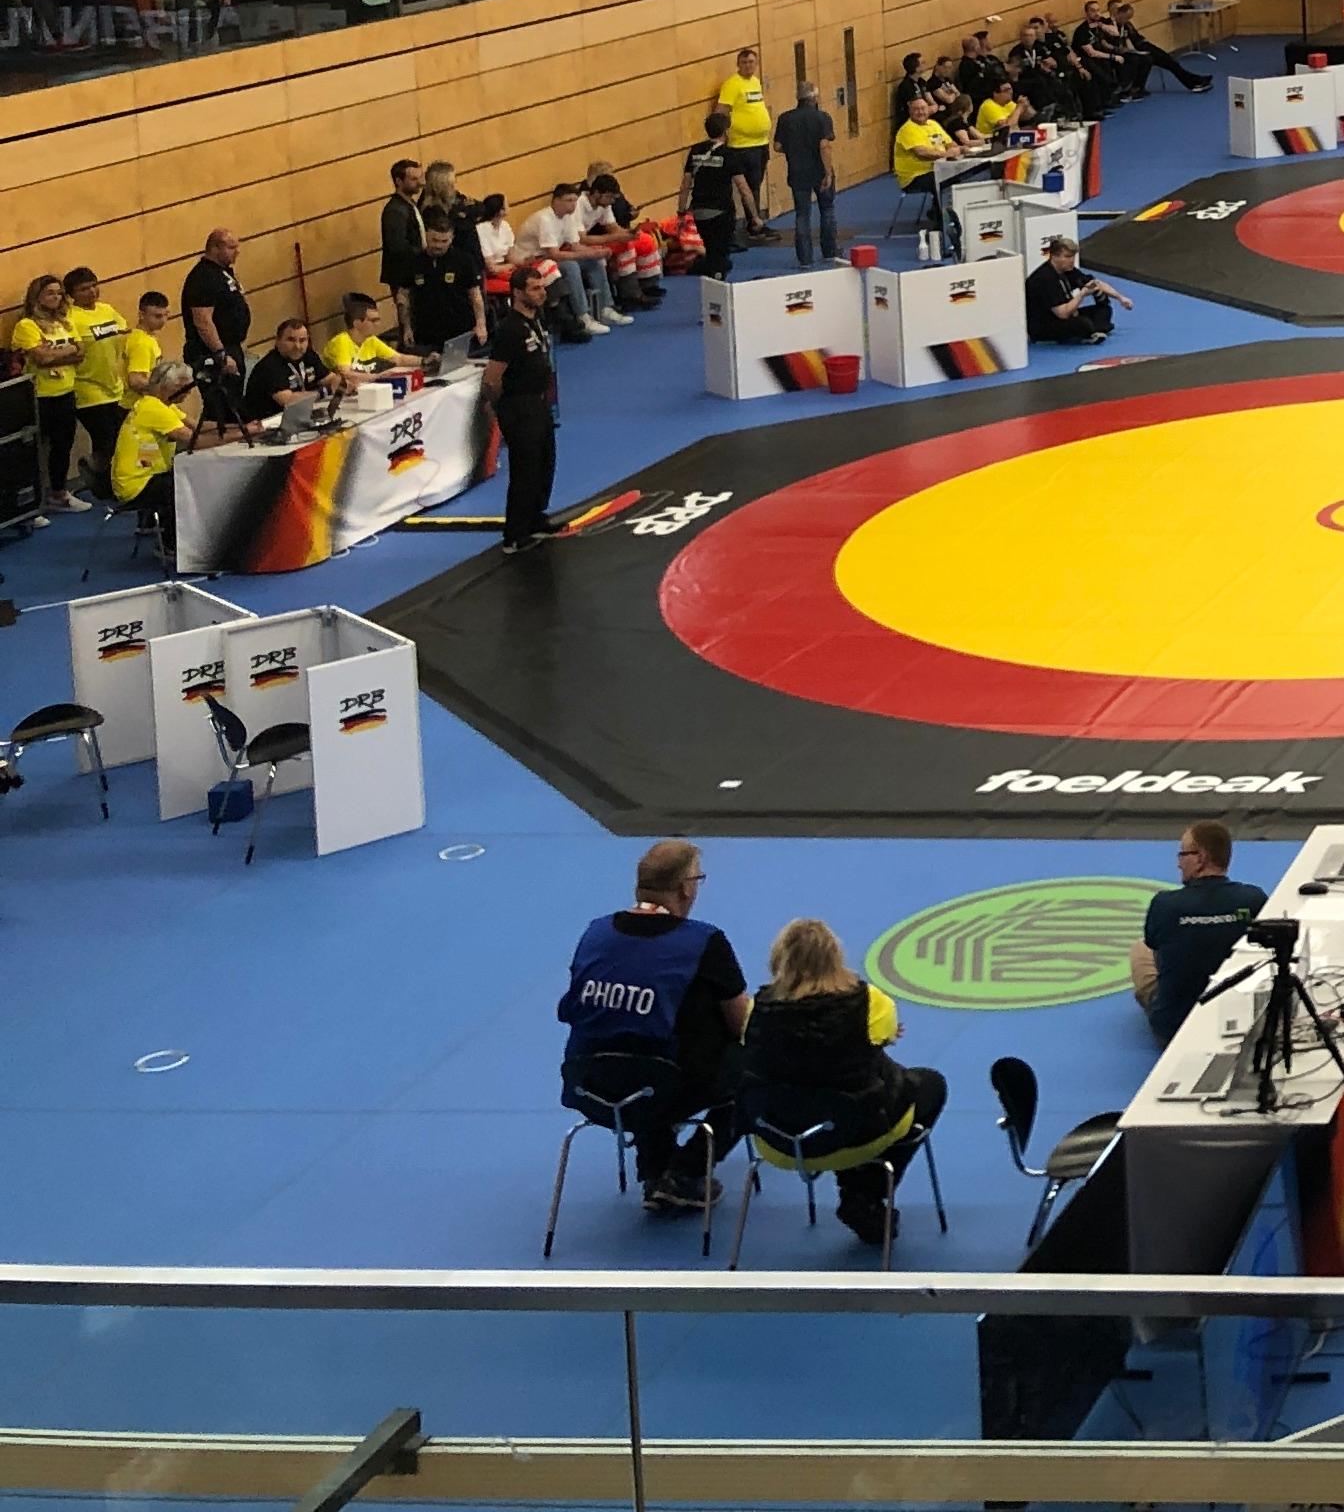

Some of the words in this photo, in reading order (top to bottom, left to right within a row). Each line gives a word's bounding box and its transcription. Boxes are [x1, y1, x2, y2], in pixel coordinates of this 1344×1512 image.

[390, 412, 423, 444] DRB
[98, 620, 143, 641] DRB
[251, 647, 297, 668] DRB
[340, 689, 385, 713] DRB
[975, 769, 1323, 795] foeldeak
[581, 979, 655, 1015] PHOTO
